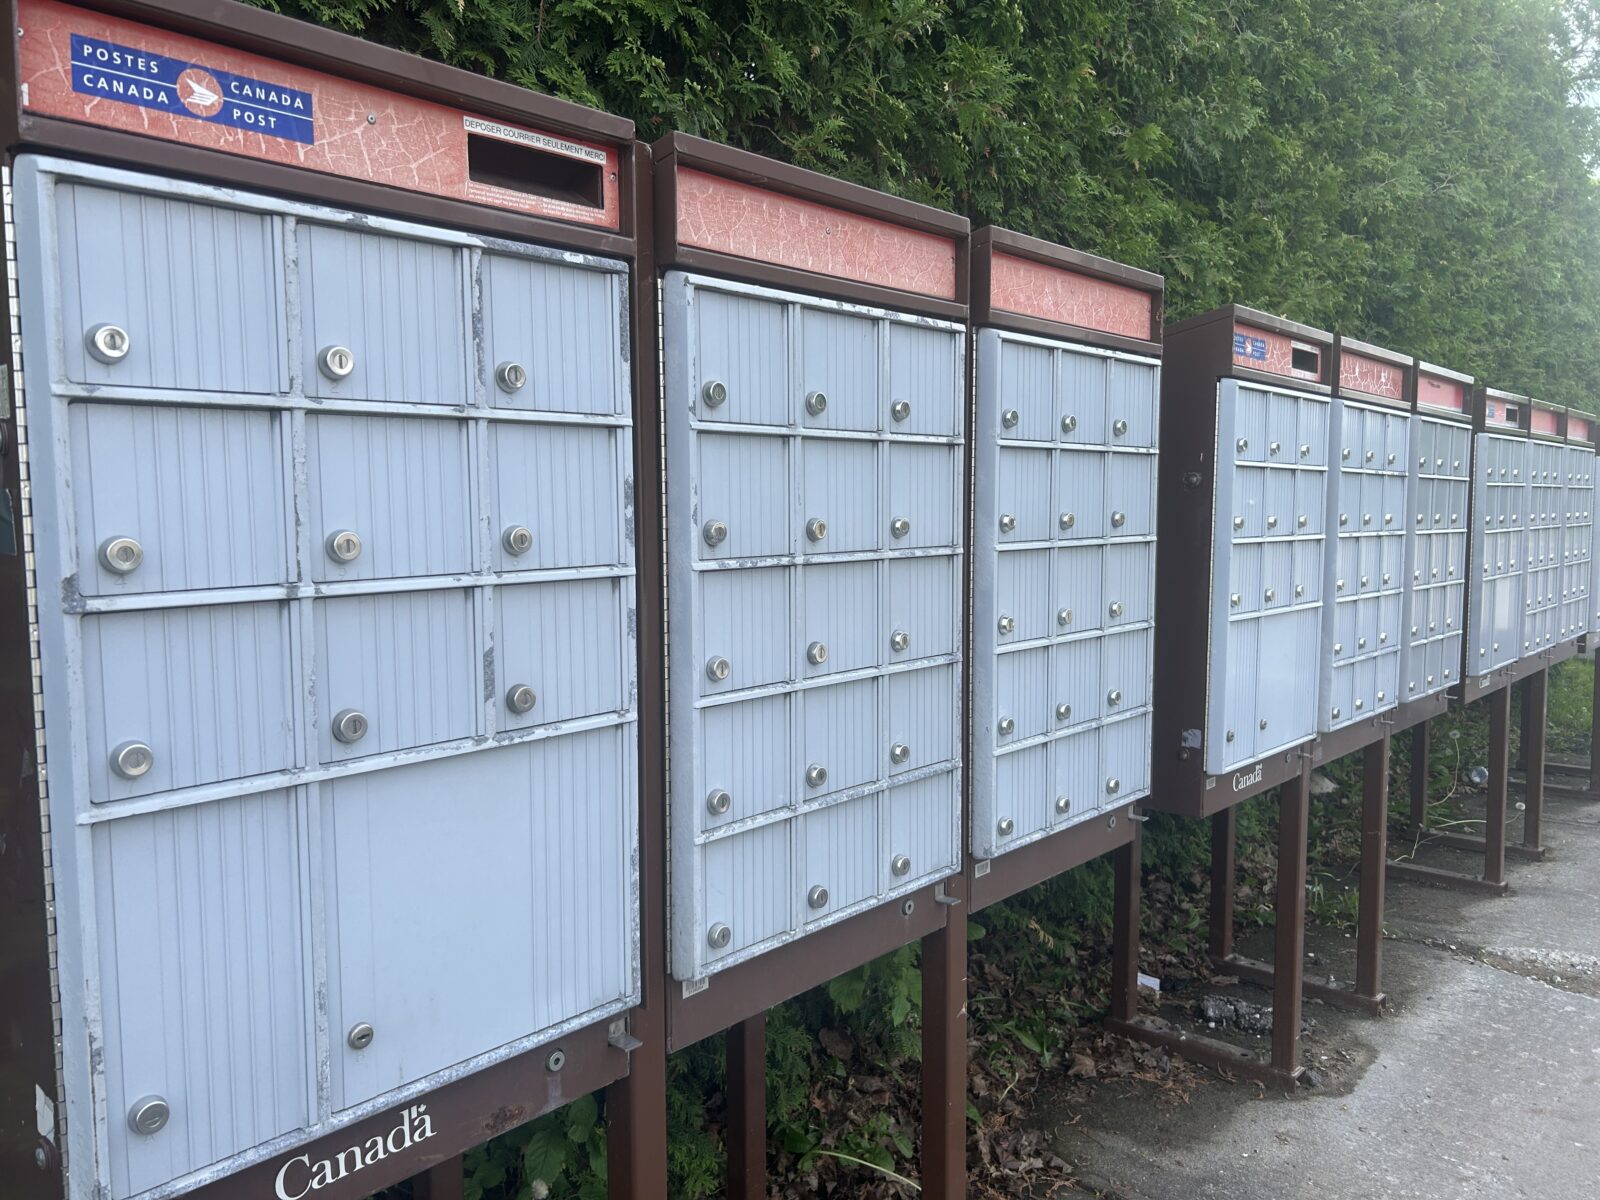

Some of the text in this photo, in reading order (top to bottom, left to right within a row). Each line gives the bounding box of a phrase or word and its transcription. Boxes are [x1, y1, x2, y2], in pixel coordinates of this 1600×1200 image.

[83, 44, 158, 73] POSTES
[83, 74, 169, 104] CANADA
[230, 82, 304, 110] CANADA
[233, 108, 277, 129] POST
[464, 119, 606, 161] DEPOSER COURRIER SEULEMENT MERCI
[1232, 763, 1263, 792] Canada
[274, 1104, 438, 1200] Canada
